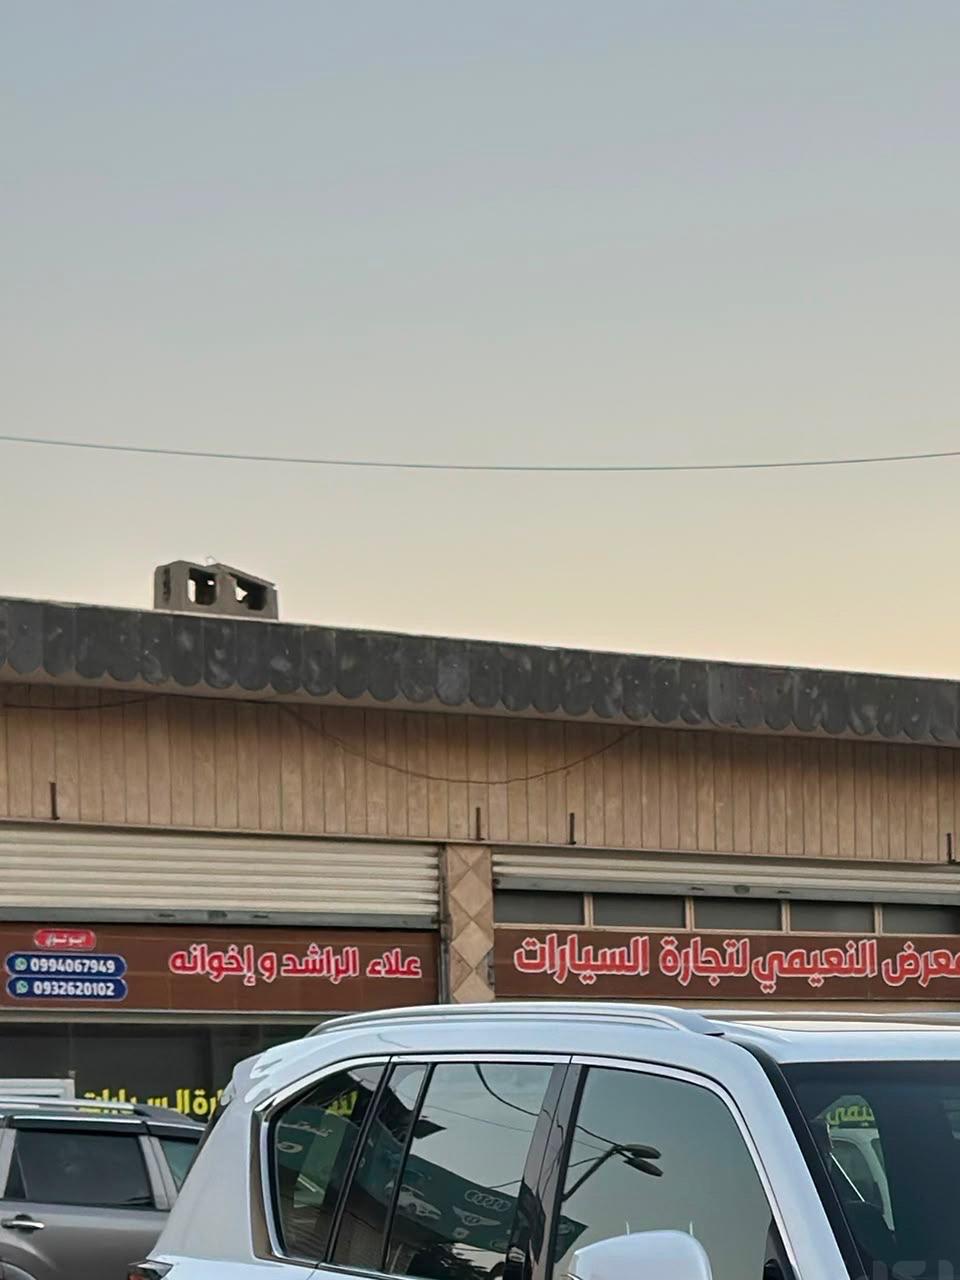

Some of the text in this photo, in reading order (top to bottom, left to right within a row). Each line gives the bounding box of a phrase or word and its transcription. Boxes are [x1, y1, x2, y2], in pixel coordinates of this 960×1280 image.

[30, 958, 116, 973] 0994067949
[281, 943, 359, 984] الراشد
[366, 948, 422, 978] علاء
[514, 933, 650, 984] السيارات
[659, 936, 750, 986] لتجارة
[752, 939, 877, 993] النعيمي
[33, 981, 115, 996] 0932620102
